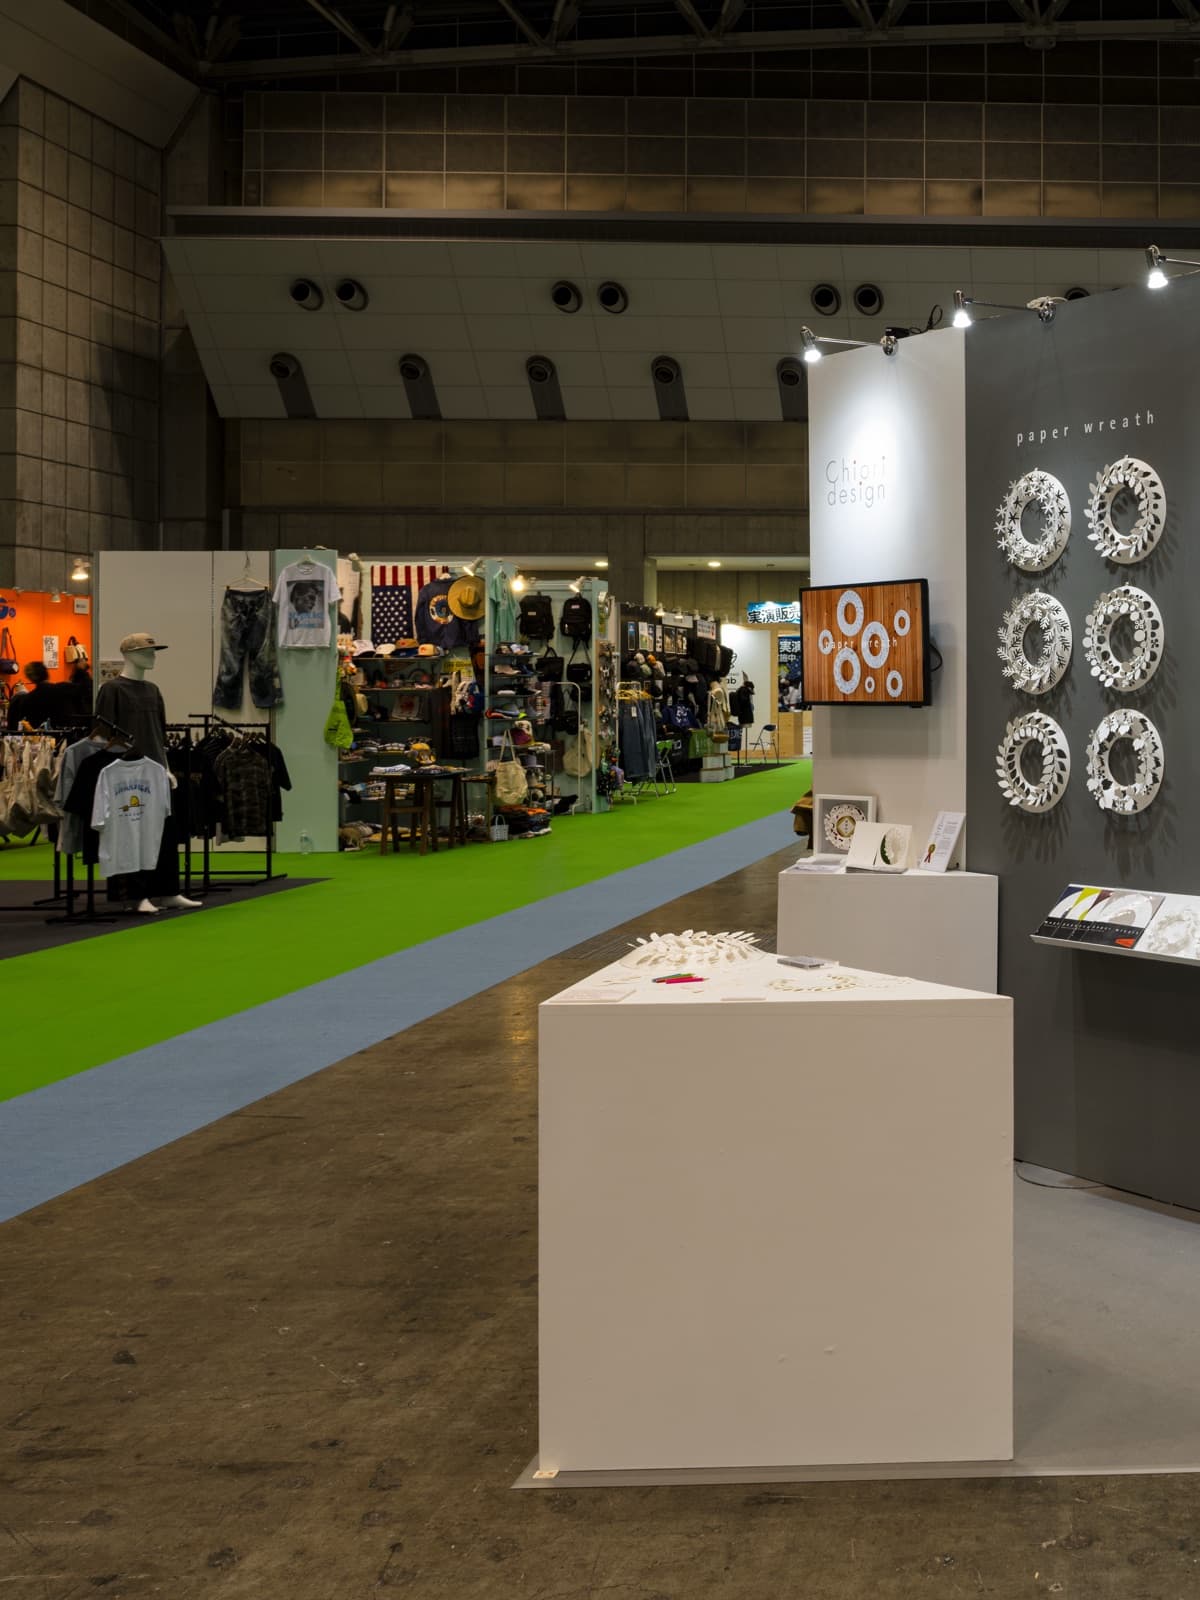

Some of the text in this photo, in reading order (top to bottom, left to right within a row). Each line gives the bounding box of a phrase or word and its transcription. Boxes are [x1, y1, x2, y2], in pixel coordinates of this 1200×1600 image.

[1017, 410, 1154, 447] paper wreath
[825, 455, 886, 484] Chiori
[827, 481, 886, 509] design
